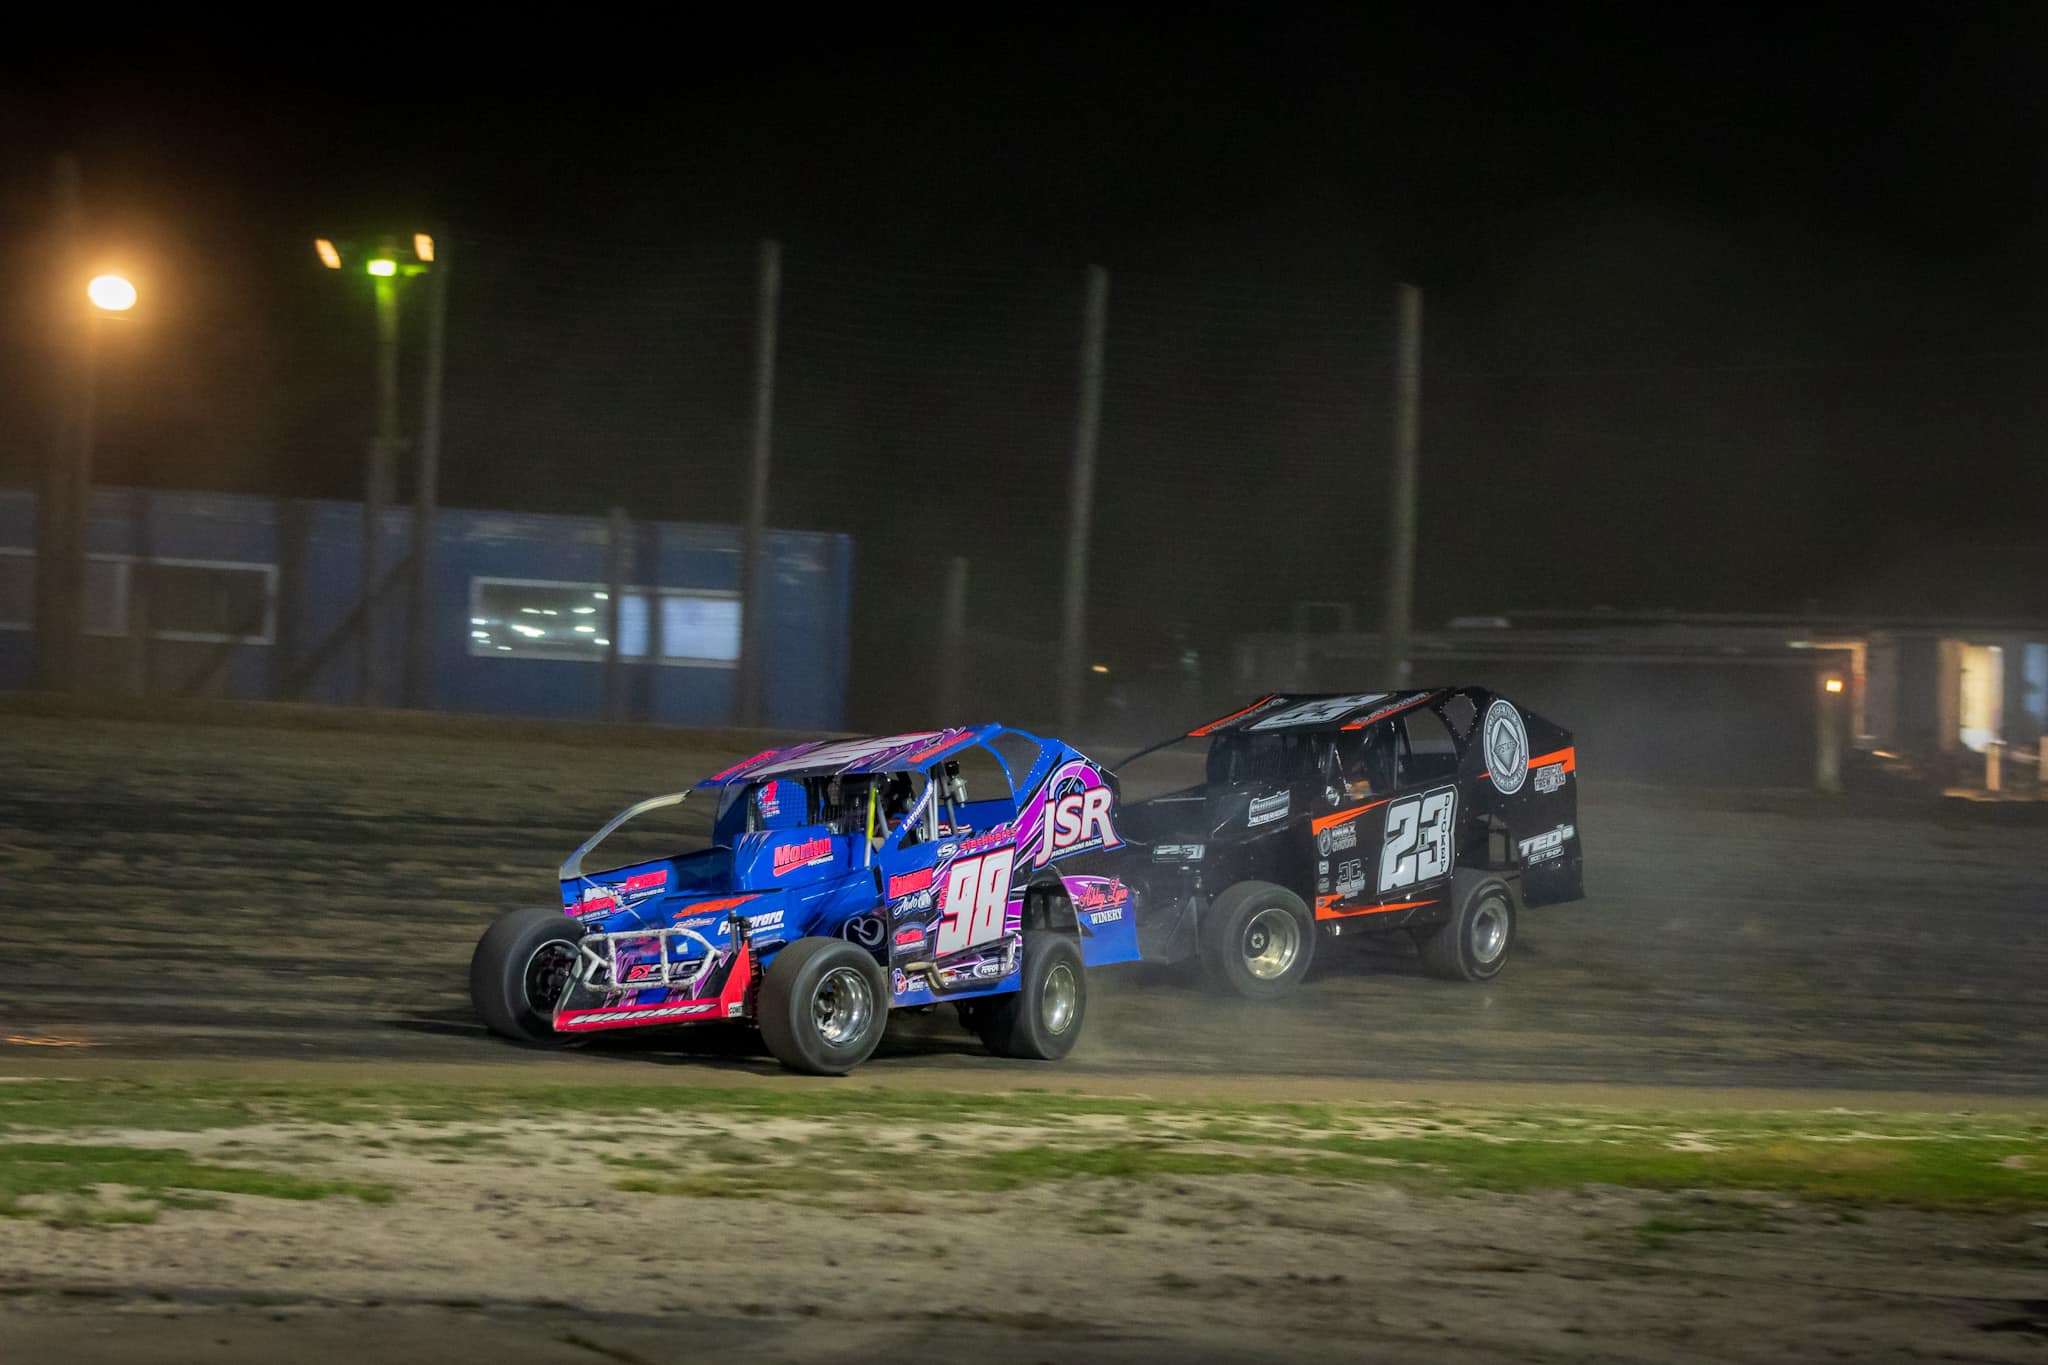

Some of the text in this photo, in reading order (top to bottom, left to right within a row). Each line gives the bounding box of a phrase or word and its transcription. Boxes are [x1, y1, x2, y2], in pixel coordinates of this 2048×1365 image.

[773, 837, 832, 868] Morrison
[1034, 786, 1121, 868] JSR
[1379, 791, 1455, 893] 23
[1440, 794, 1451, 873] DICKEY
[935, 850, 1015, 958] 98
[1090, 907, 1123, 925] WINERY
